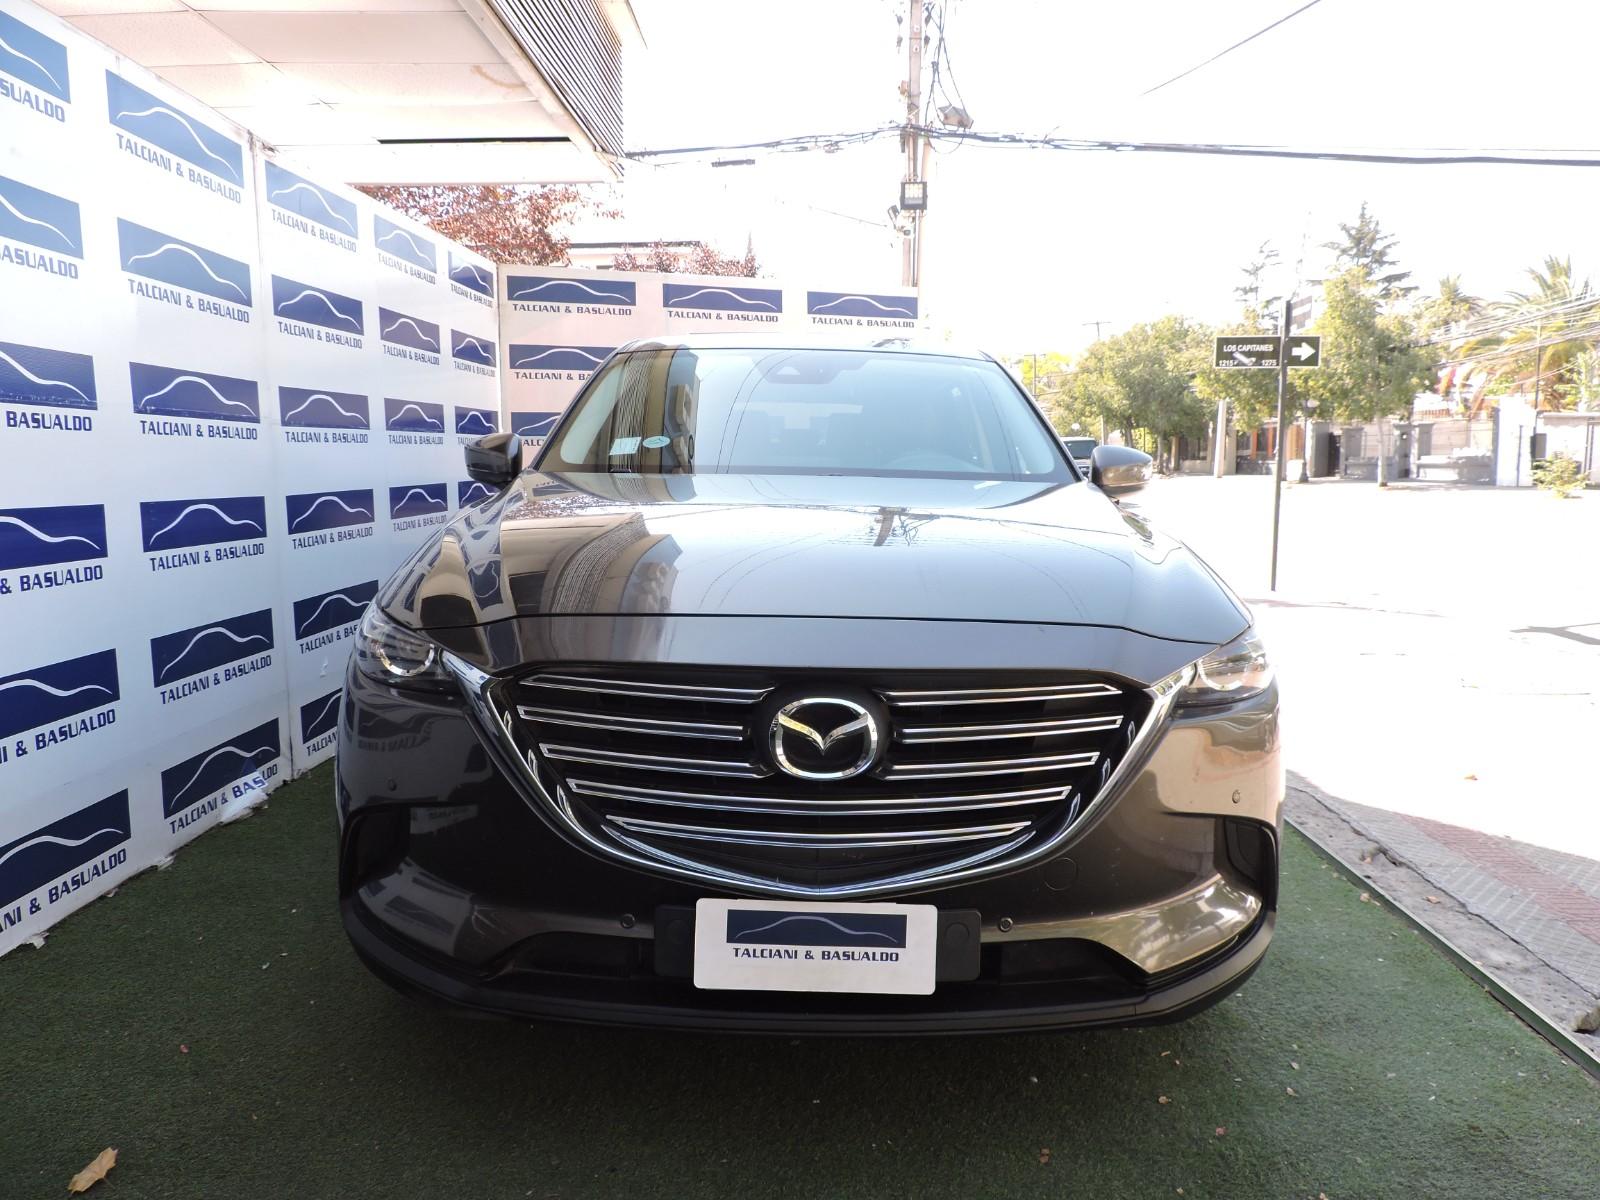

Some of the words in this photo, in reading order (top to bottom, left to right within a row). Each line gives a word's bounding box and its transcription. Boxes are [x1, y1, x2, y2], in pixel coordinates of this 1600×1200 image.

[116, 133, 171, 172] TALCIANI
[176, 162, 185, 178] &
[188, 167, 241, 204] BASUALDO
[272, 209, 308, 235] TALCIANI
[311, 226, 316, 237] &
[319, 229, 357, 253] BASUALDO
[0, 245, 79, 279] ASUALDO
[128, 278, 182, 306] TALCIANI
[186, 295, 194, 309] &
[198, 297, 250, 323] BASUALDO
[513, 304, 560, 313] TALCIANI
[576, 306, 632, 316] BASUALDO
[667, 310, 712, 320] TALCIANI
[716, 312, 723, 320] &
[727, 313, 778, 323] BASUALDO
[811, 317, 852, 327] TALCIANI
[857, 319, 863, 327] &
[867, 320, 915, 329] BASUALDO
[278, 321, 314, 339] TALCIANI
[316, 330, 322, 341] &
[325, 332, 362, 349] BASUALDO
[383, 344, 408, 359] TALCIANI
[409, 349, 413, 360] &
[414, 351, 440, 366] BASUALDO
[1223, 344, 1237, 352] LOS
[1237, 344, 1273, 352] CAPITANES
[514, 372, 562, 380] TALCIANI
[566, 373, 573, 381] &
[6, 411, 92, 432] BASUALDO
[140, 420, 192, 437] TALCIANI
[196, 424, 204, 437] &
[208, 425, 258, 440] BASUALDO
[285, 432, 321, 443] TALCIANI
[324, 433, 329, 443] &
[332, 433, 368, 444] BASUALDO
[388, 434, 413, 445] TALCIANI
[414, 435, 418, 445] &
[420, 435, 443, 444] BASUALDO
[393, 520, 416, 531] TALCIANI
[292, 535, 327, 549] TALCIANI
[330, 533, 335, 543] &
[338, 527, 373, 543] BASUALDO
[150, 552, 200, 572] TALCIANI
[204, 551, 211, 563] &
[216, 543, 265, 561] BASUALDO
[0, 578, 12, 595] &
[20, 565, 103, 592] BASUALDO
[300, 633, 334, 654] TALCIANI
[336, 630, 341, 640] &
[160, 679, 209, 705] TALCIANI
[213, 674, 220, 686] &
[224, 654, 272, 682] BASUALDO
[15, 740, 28, 759] &
[35, 709, 116, 751] BASUALDO
[169, 797, 217, 834] TALCIANI
[221, 792, 228, 806] &
[29, 897, 42, 916] &
[48, 848, 127, 905] BASUALDO
[733, 947, 798, 960] TALCIANI
[804, 949, 815, 960] &
[821, 950, 899, 962] BASUALDO
